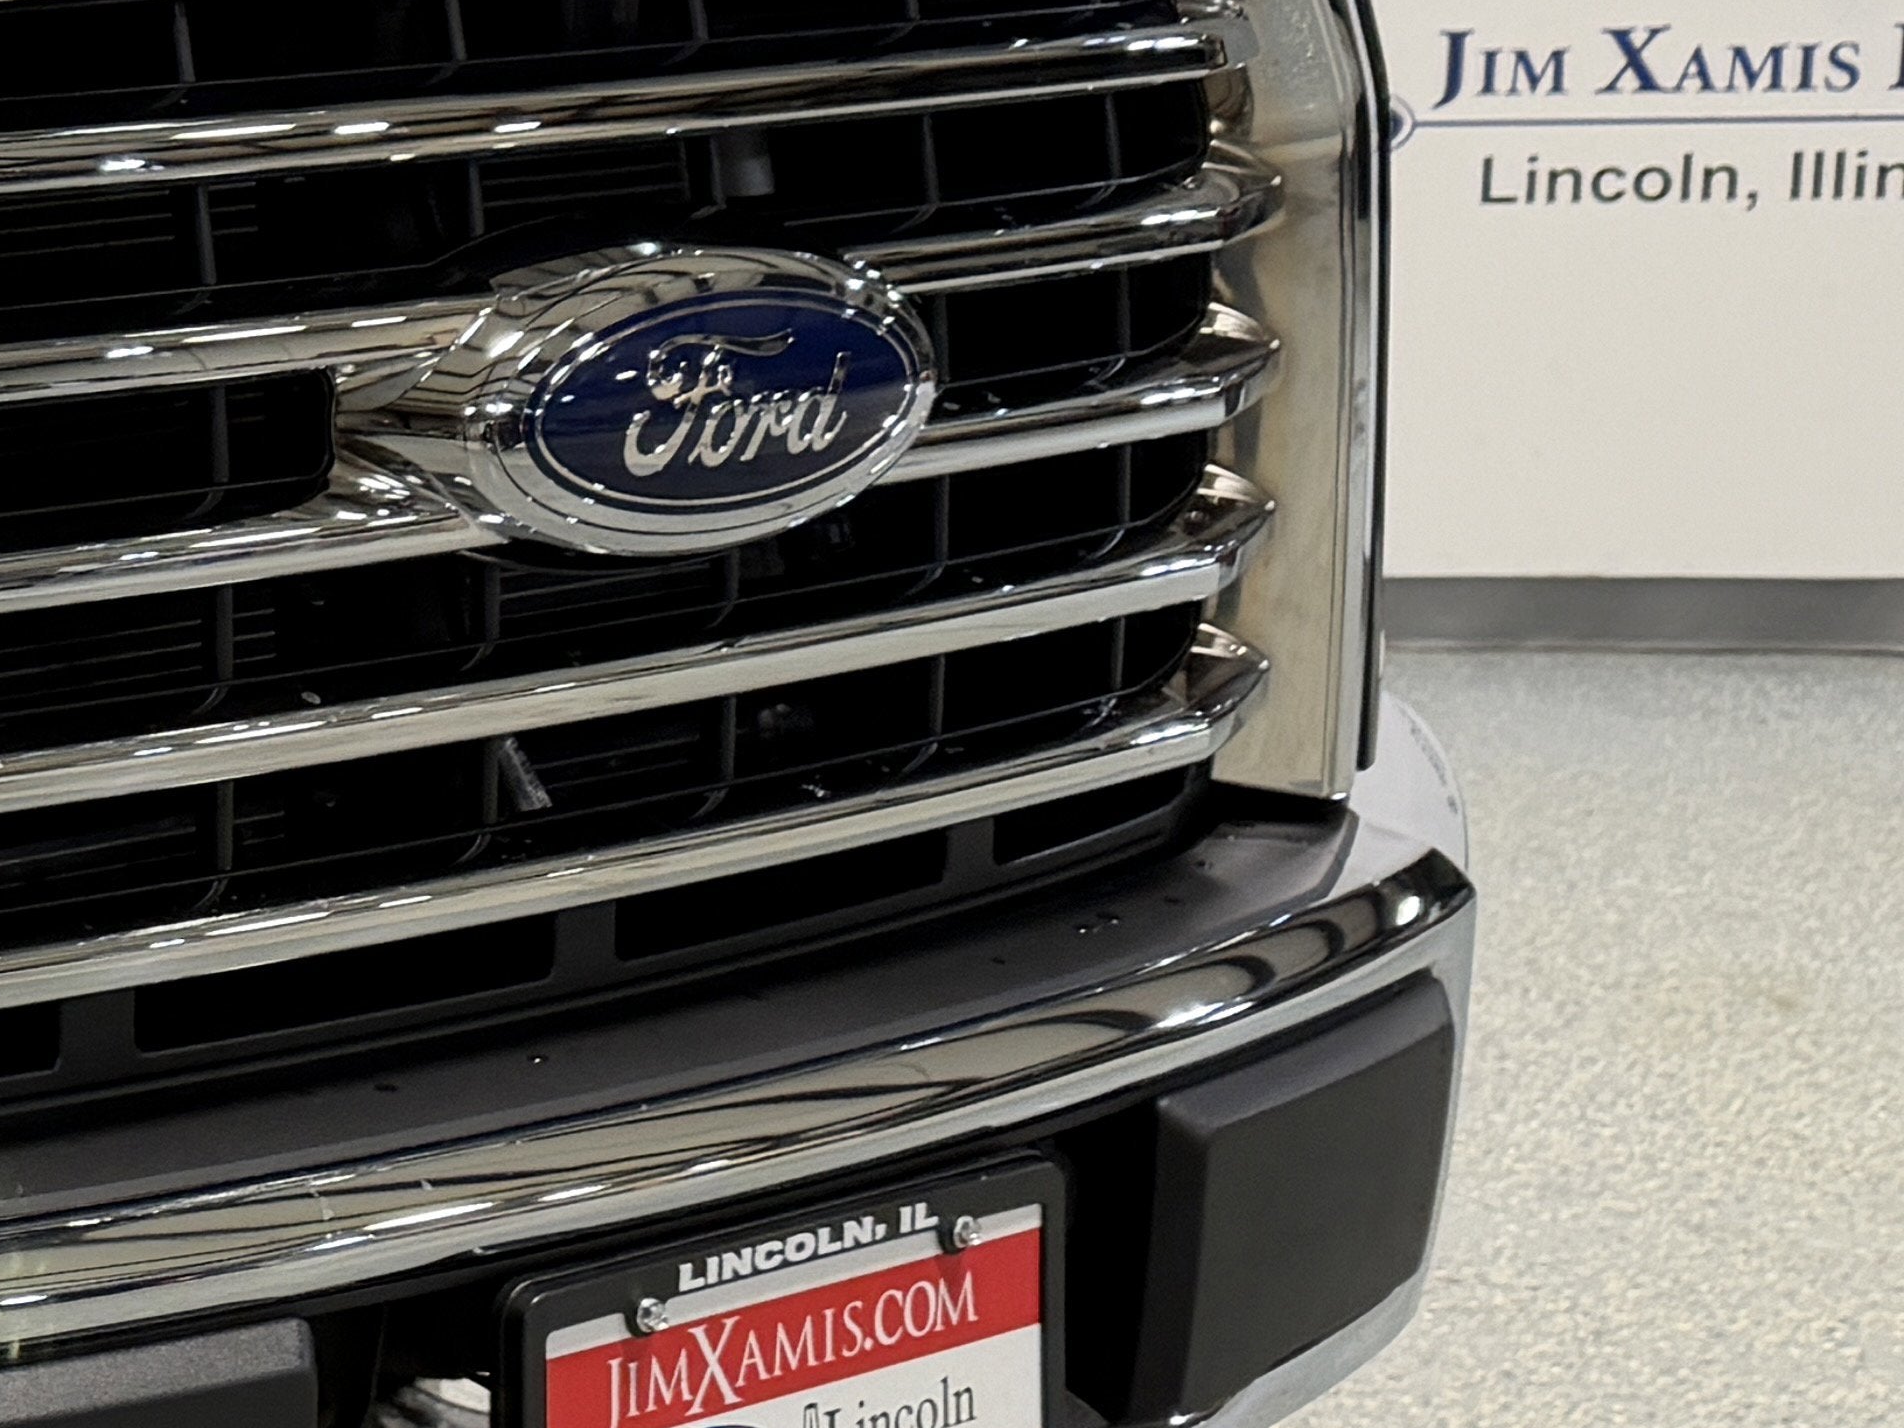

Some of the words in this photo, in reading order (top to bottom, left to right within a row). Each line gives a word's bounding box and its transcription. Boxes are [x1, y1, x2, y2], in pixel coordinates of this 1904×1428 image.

[1432, 26, 1572, 110] JIM
[1594, 22, 1863, 95] XAMIS
[1479, 151, 1760, 212] Lincoln,
[623, 328, 852, 478] Ford
[678, 1215, 888, 1293] LINCOLN,
[899, 1202, 940, 1234] IL
